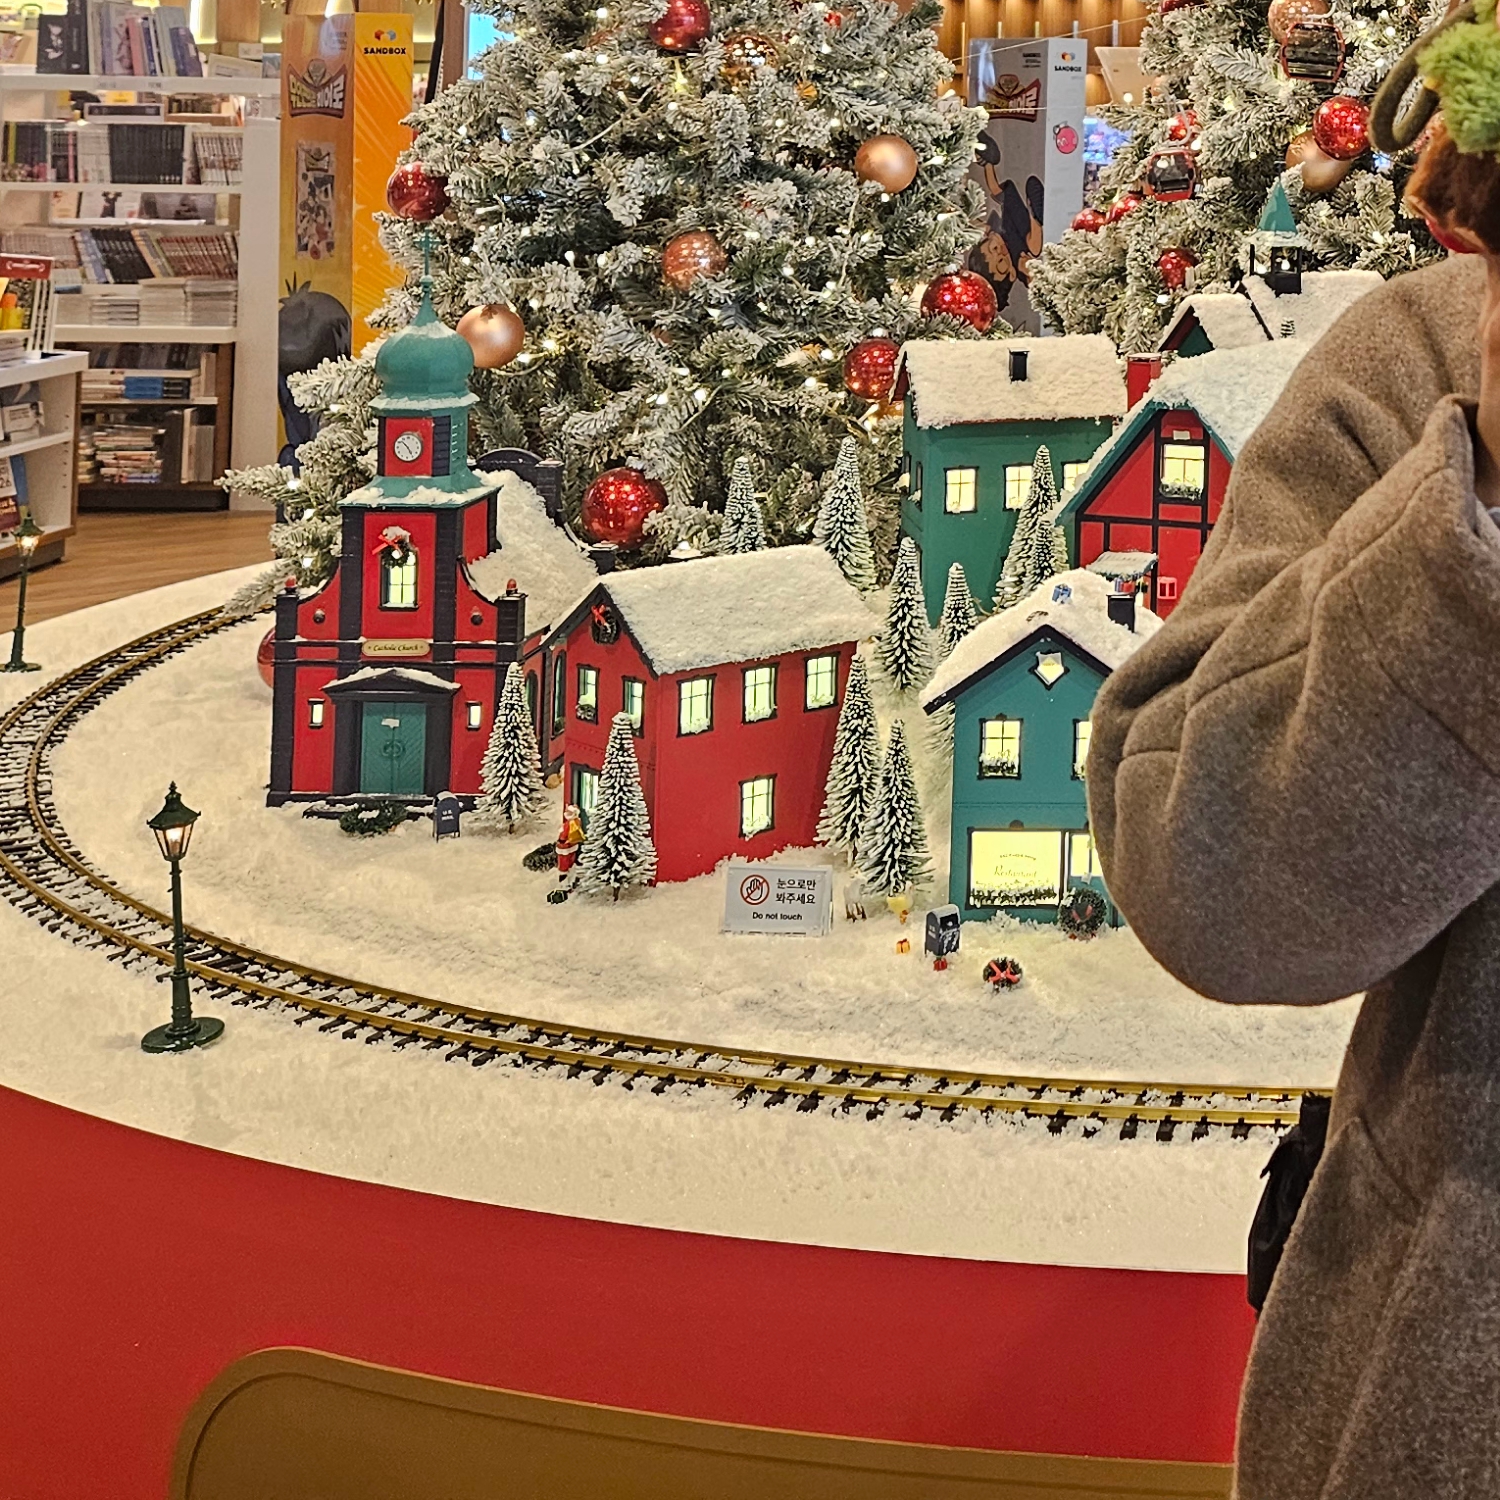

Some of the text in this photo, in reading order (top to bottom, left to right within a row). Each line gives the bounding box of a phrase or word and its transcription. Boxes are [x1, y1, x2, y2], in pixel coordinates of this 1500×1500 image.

[363, 47, 406, 55] SANDBOX
[373, 643, 418, 652] Catholic Church
[776, 878, 816, 891] 눈으로만
[776, 892, 816, 904] 봐주세요
[752, 912, 803, 921] Do not touch
